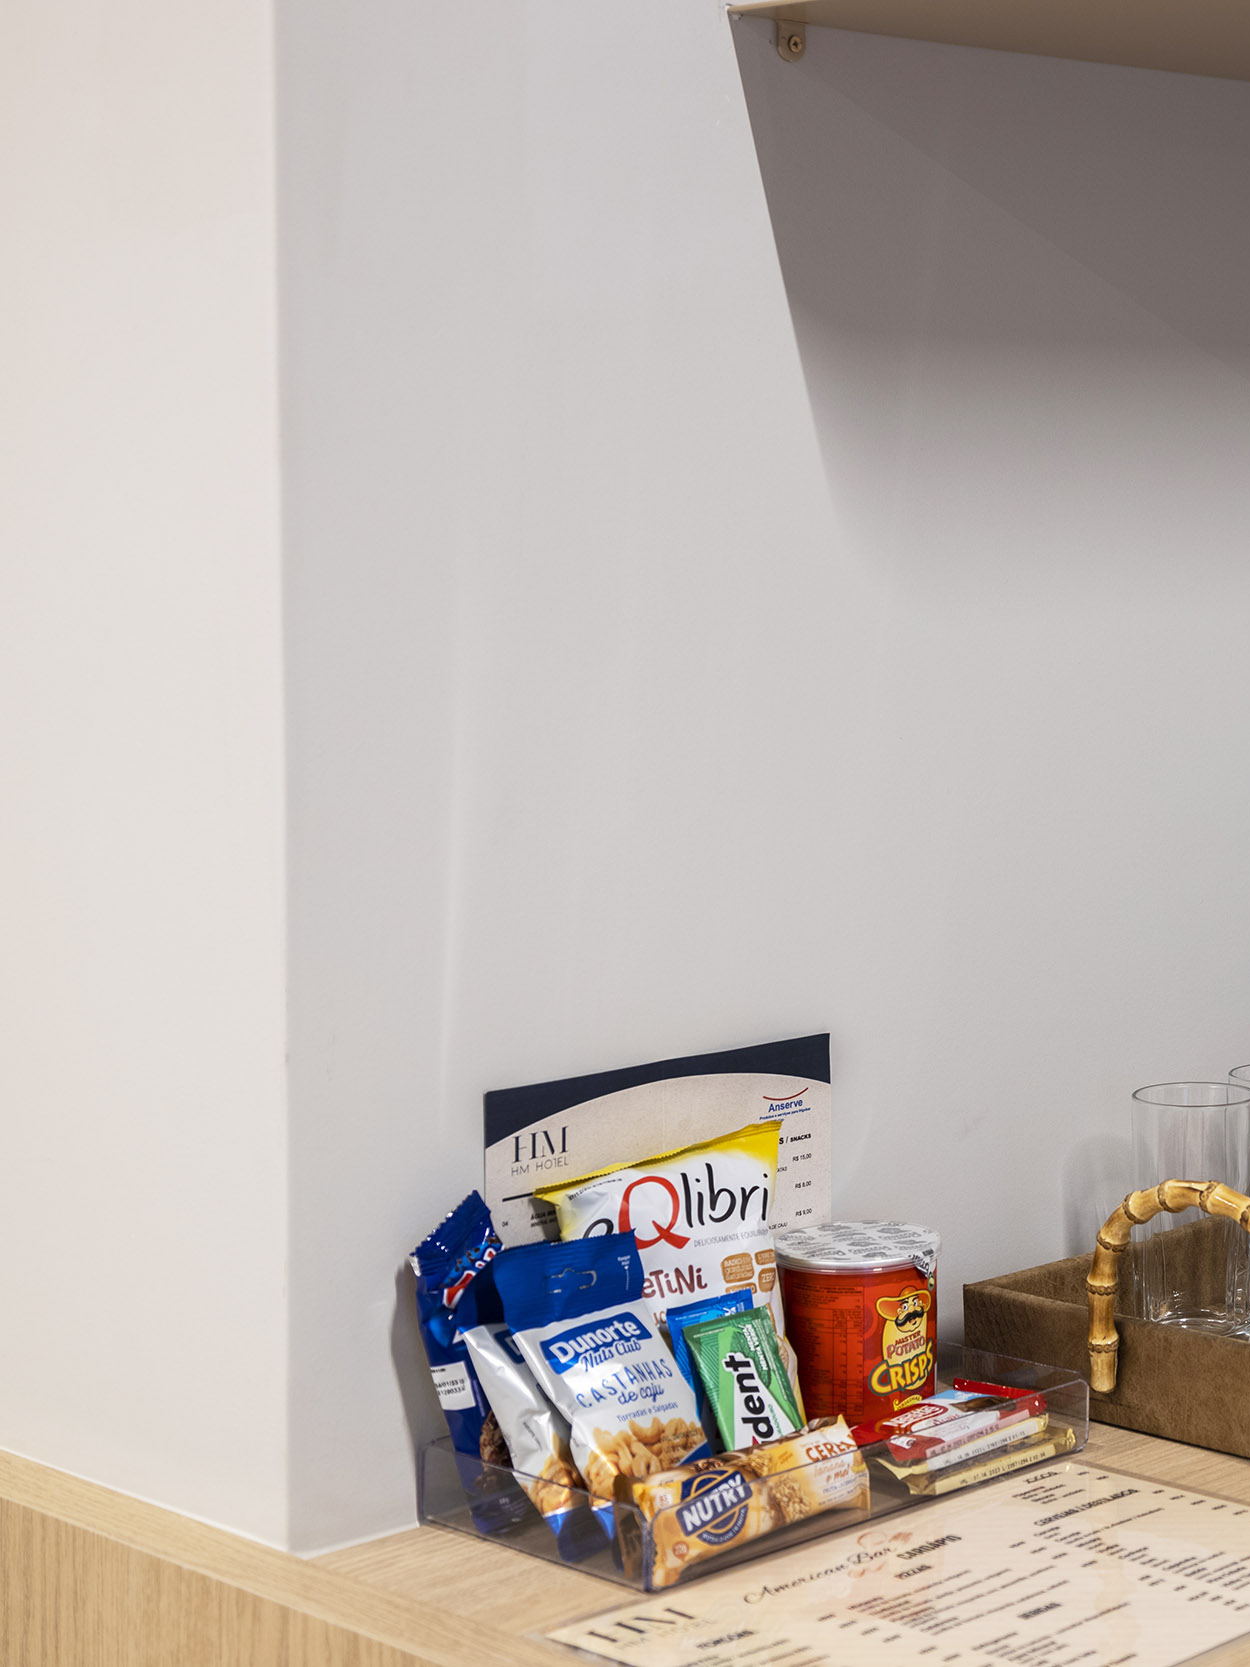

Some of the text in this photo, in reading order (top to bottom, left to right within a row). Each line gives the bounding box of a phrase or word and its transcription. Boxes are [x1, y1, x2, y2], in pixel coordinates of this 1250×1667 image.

[769, 1099, 803, 1112] Anserve
[512, 1126, 569, 1163] HM
[790, 1133, 812, 1143] SNACKS
[511, 1157, 569, 1177] HM HOTEL
[549, 1321, 641, 1364] Dunorte
[579, 1338, 642, 1372] Nuts Club
[886, 1336, 926, 1359] POTATO
[895, 1330, 921, 1346] MISTER
[576, 1358, 673, 1409] CASTANHAS
[870, 1339, 933, 1395] CRISPS
[617, 1383, 664, 1405] de caju
[724, 1355, 774, 1440] dent
[682, 1473, 747, 1532] NUTRY
